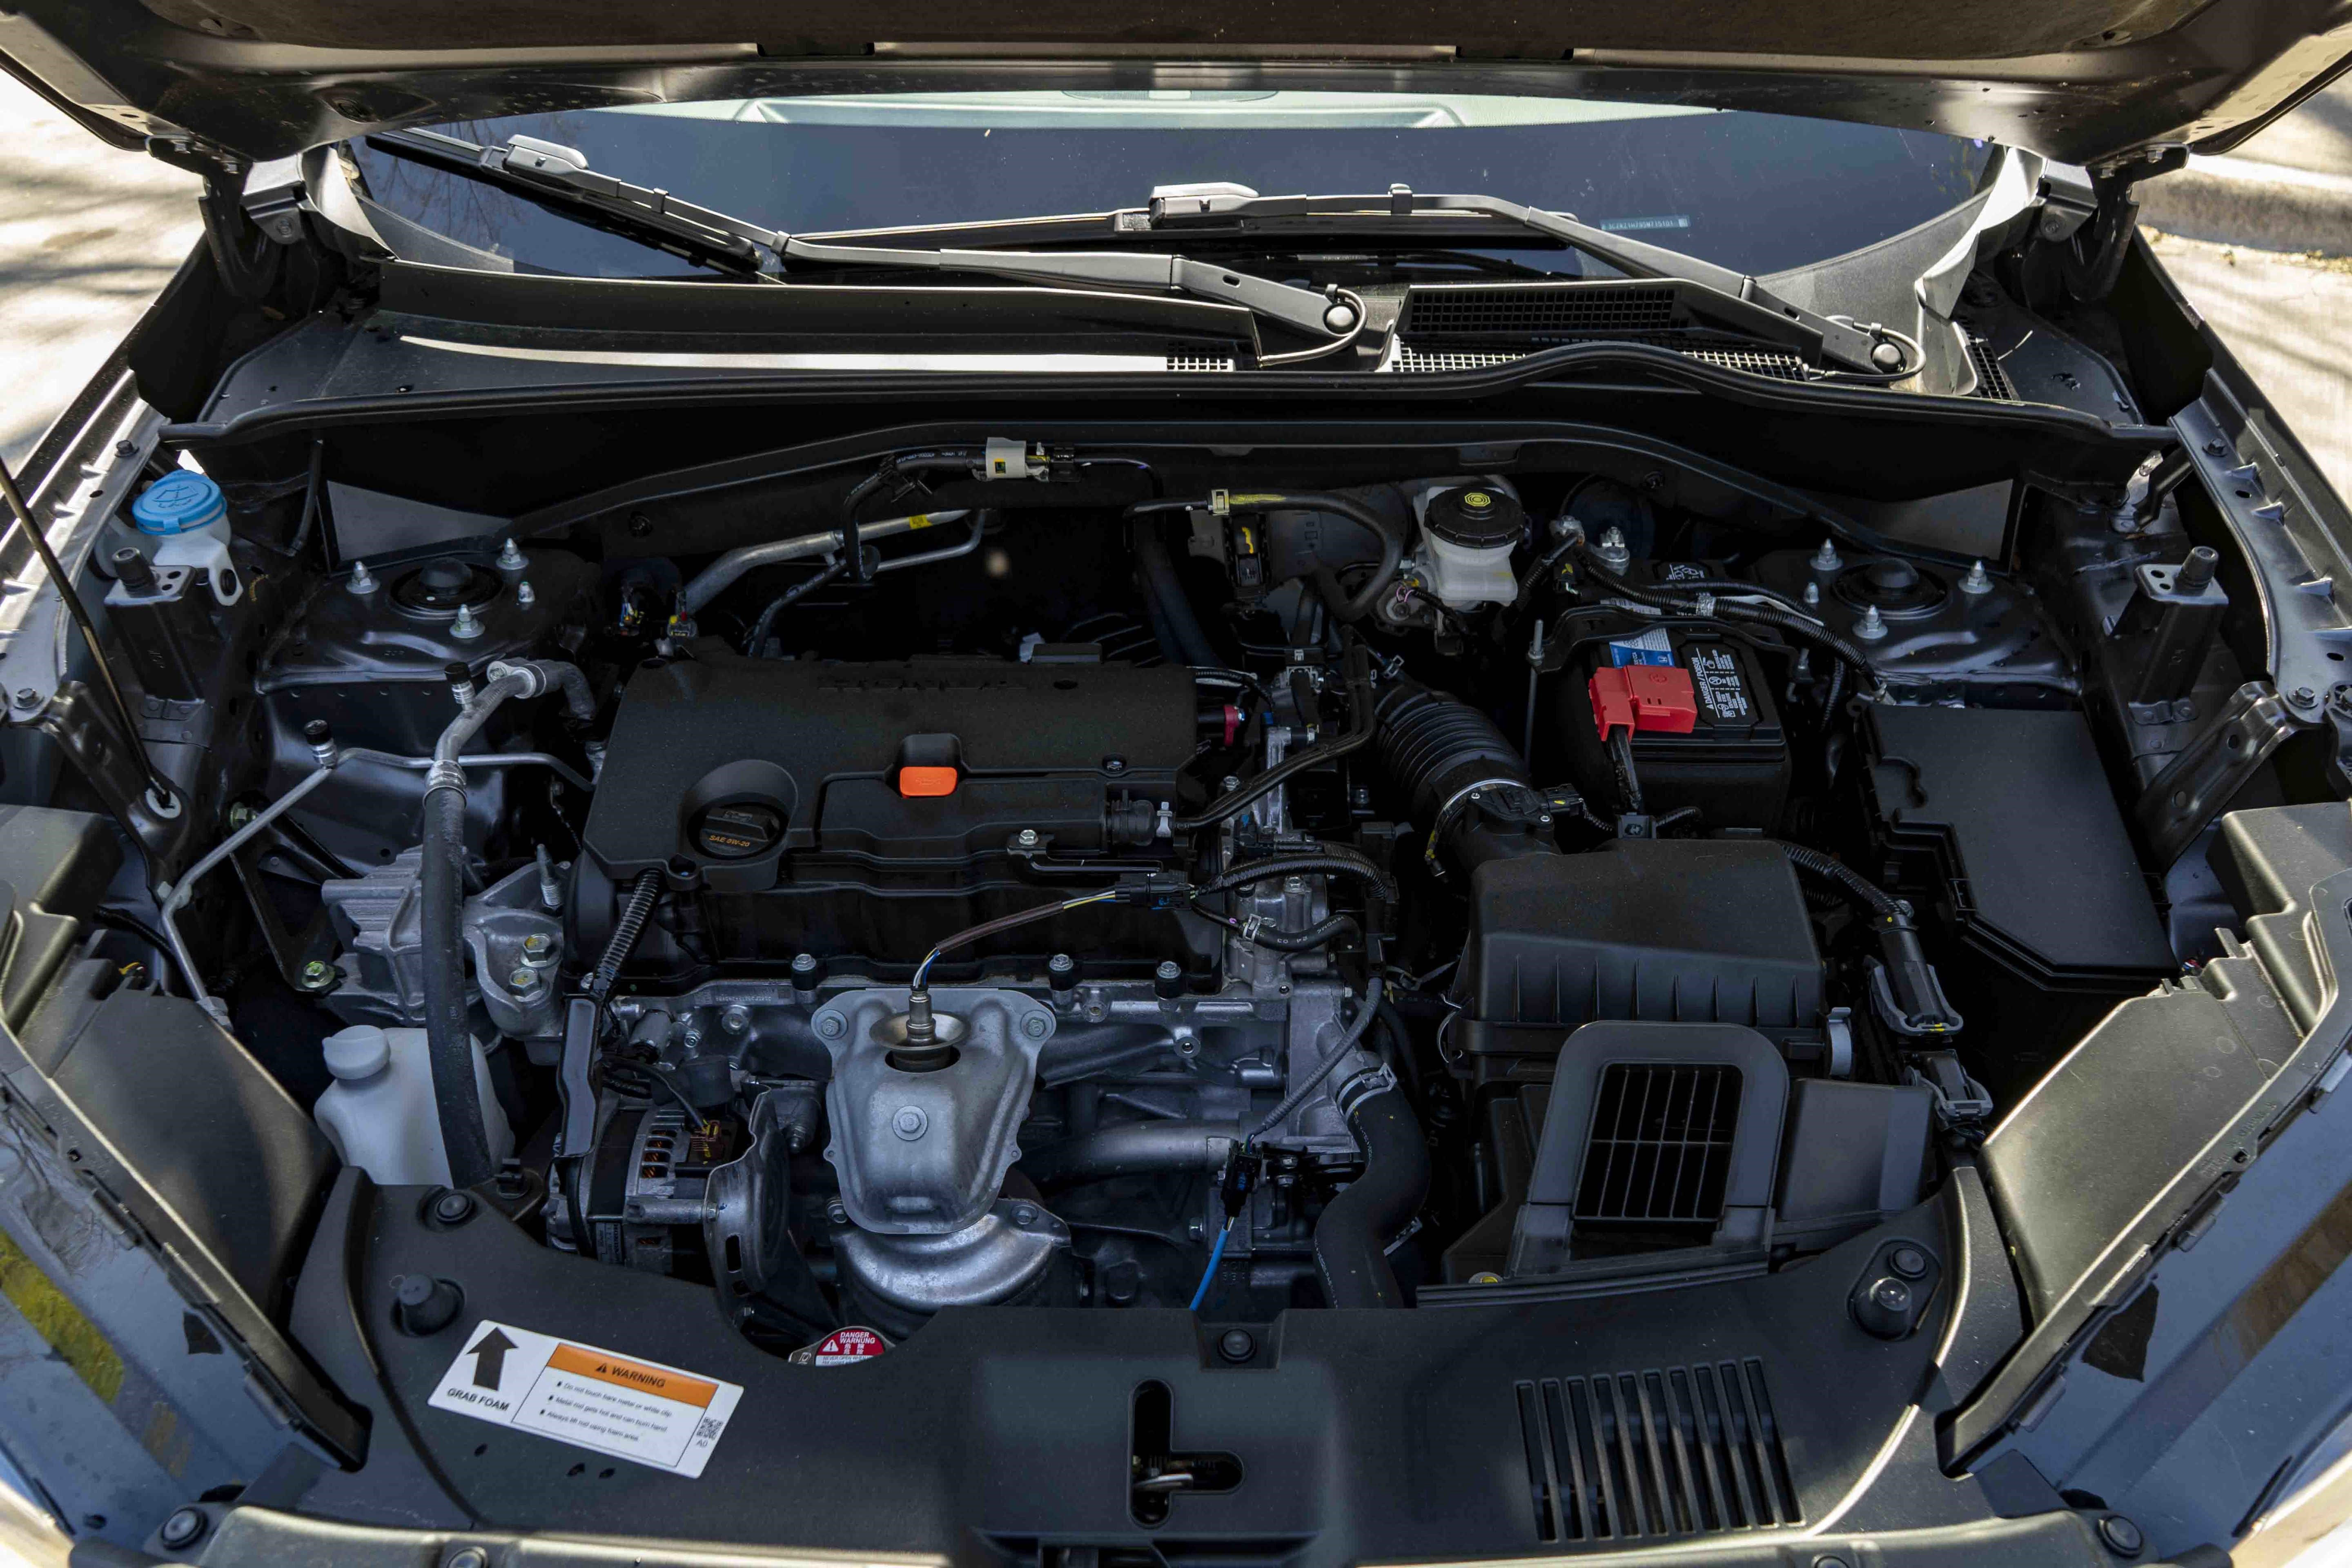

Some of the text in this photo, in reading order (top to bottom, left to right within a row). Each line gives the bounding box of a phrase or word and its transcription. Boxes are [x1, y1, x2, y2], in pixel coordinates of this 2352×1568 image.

[1691, 657, 1704, 677] POISON
[1699, 682, 1713, 704] DANGER
[709, 835, 750, 847] SAE 0W-20
[612, 1365, 666, 1387] WARNING
[447, 1388, 510, 1411] GRAB FOAM
[556, 1396, 572, 1406] Metal
[584, 1405, 597, 1413] gets
[610, 1411, 622, 1419] and
[585, 1388, 602, 1398] touch
[618, 1398, 635, 1408] metal
[547, 1410, 568, 1423] Always
[590, 1423, 606, 1433] using
